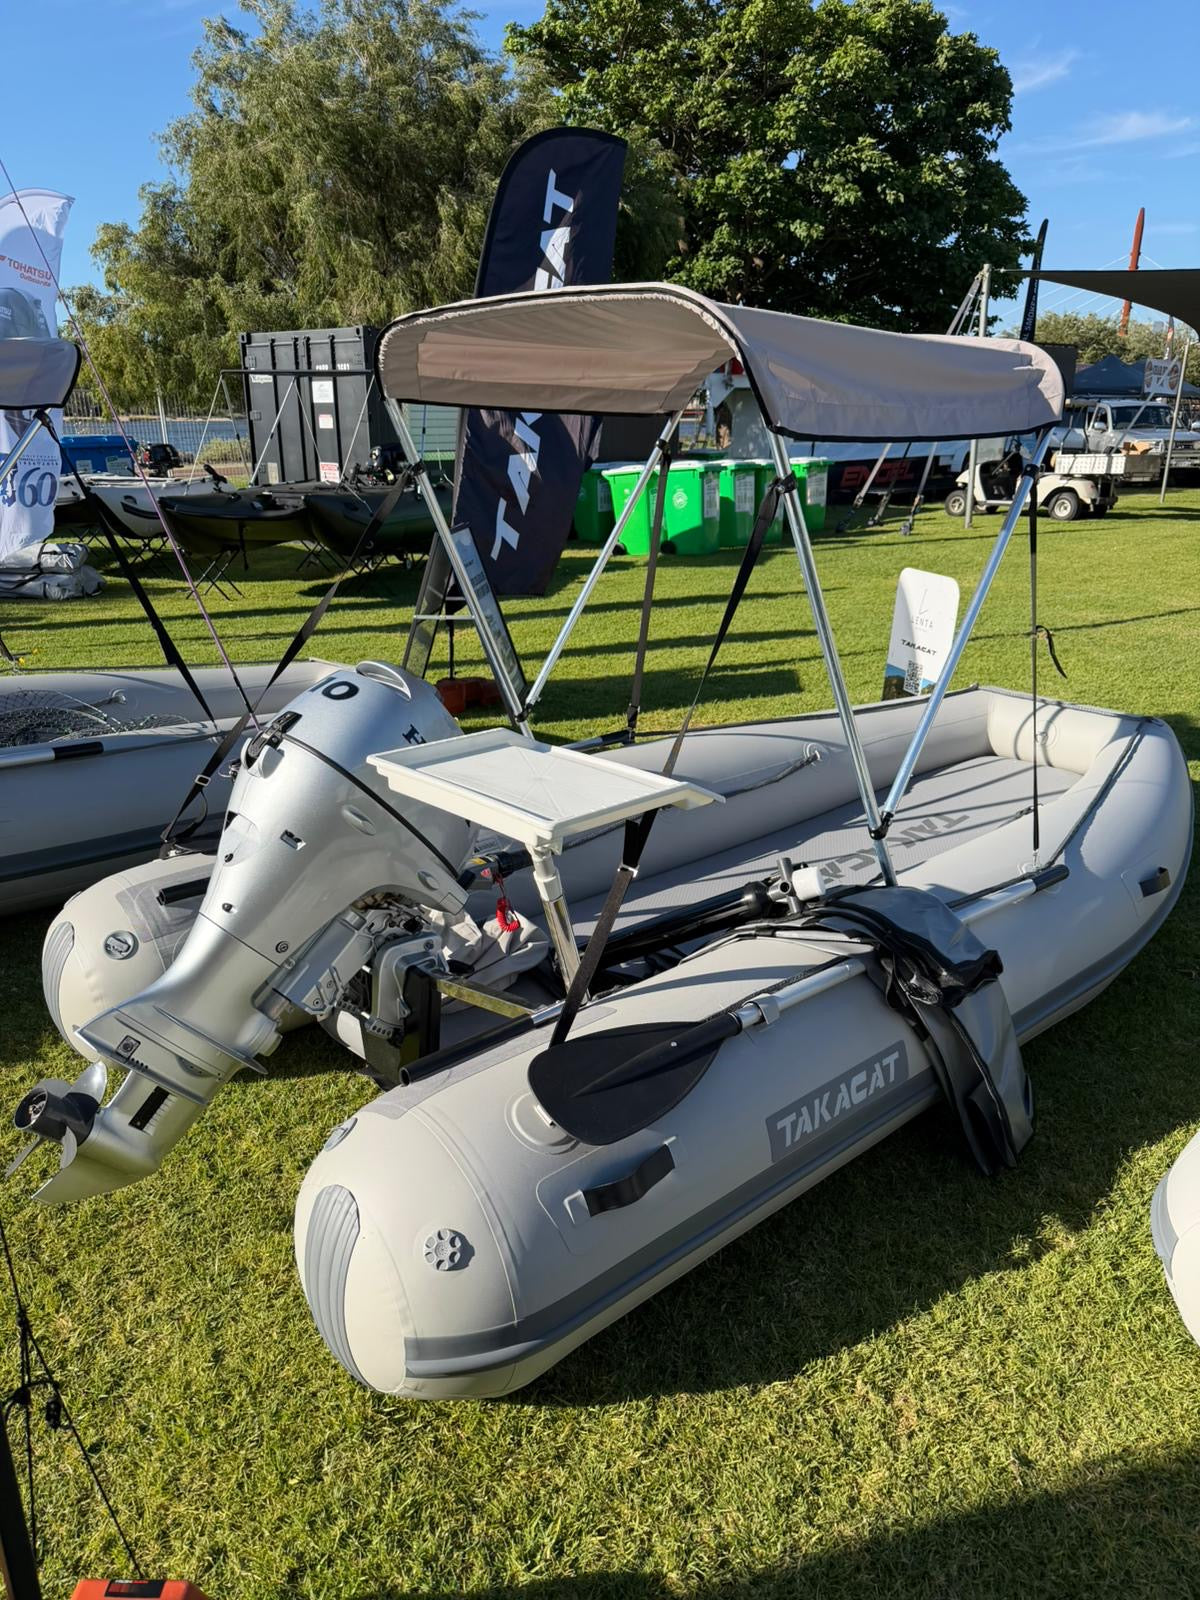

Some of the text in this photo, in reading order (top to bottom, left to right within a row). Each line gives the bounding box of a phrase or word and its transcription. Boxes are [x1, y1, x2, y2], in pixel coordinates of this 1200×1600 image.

[7, 257, 52, 280] TOHATSU
[18, 467, 57, 508] 60
[901, 639, 937, 656] TAKACAT
[776, 1051, 899, 1147] TAKACAT
